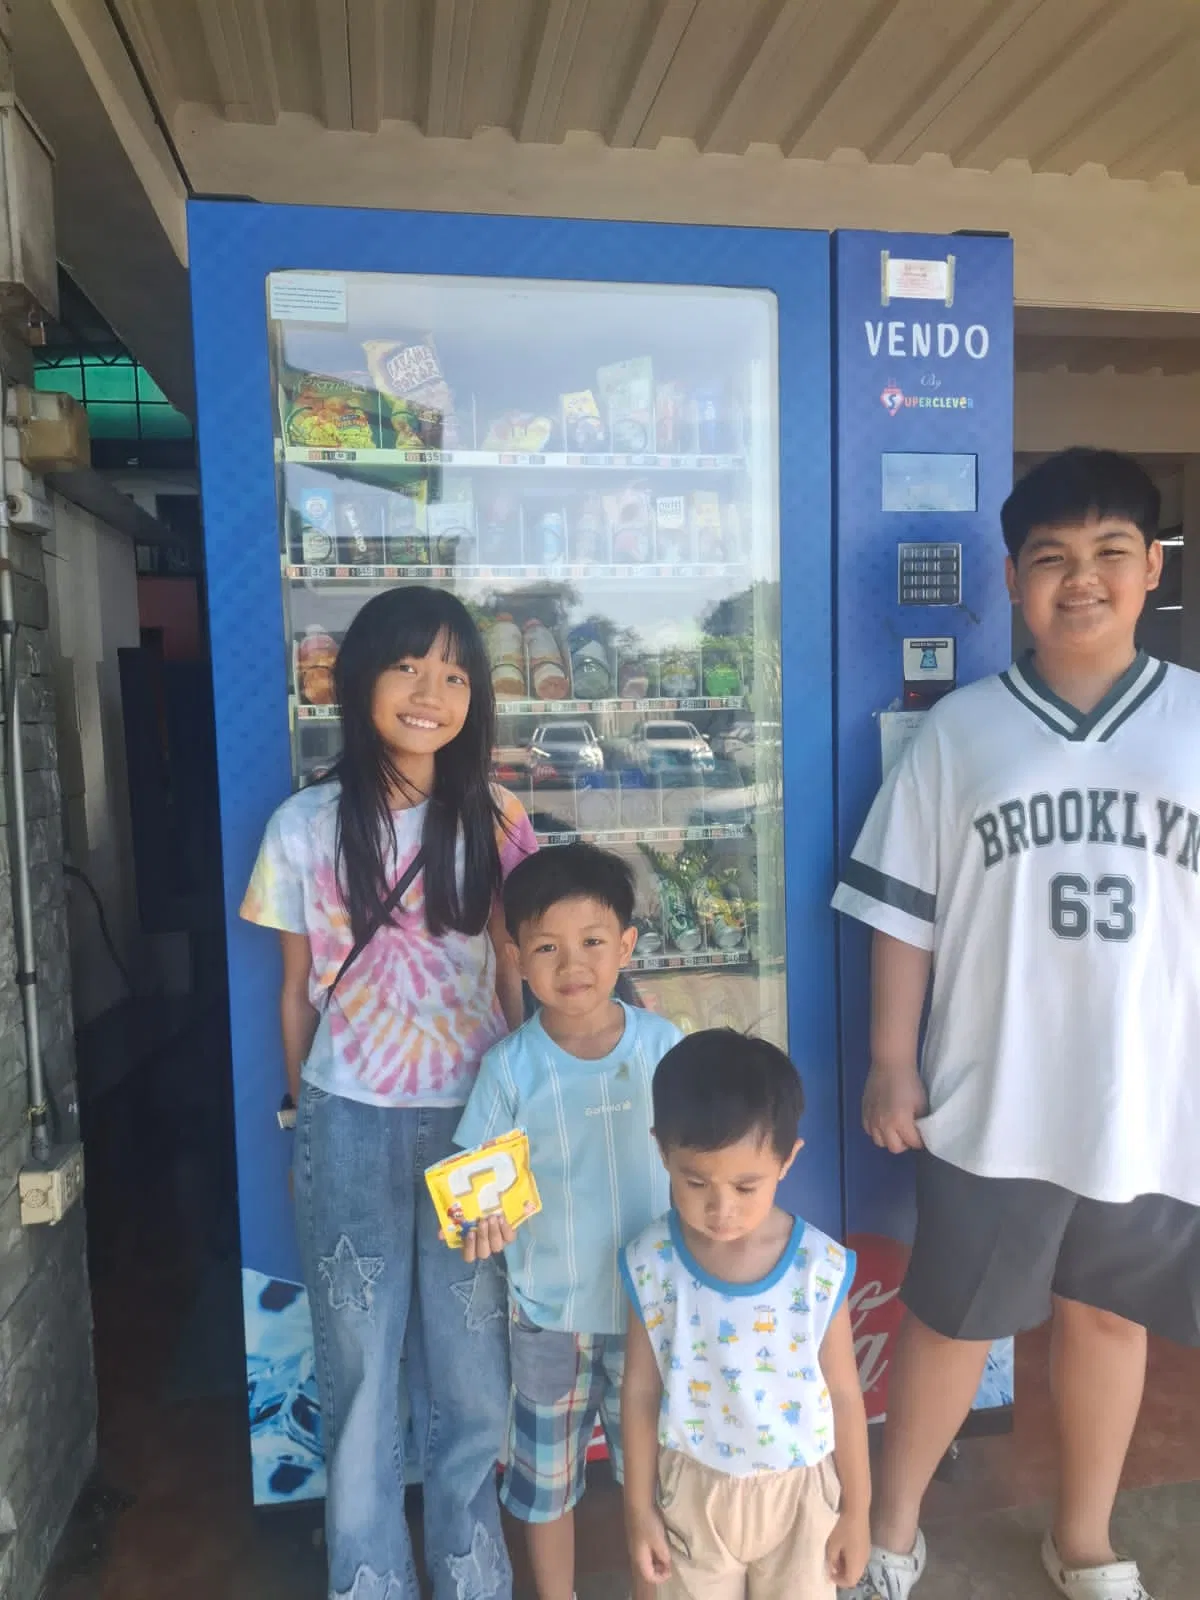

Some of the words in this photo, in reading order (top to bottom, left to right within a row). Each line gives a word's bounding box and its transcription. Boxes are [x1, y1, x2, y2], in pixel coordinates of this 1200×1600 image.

[864, 320, 990, 360] VENDO
[972, 786, 1200, 876] BROOKLYN
[1049, 872, 1136, 942] 63
